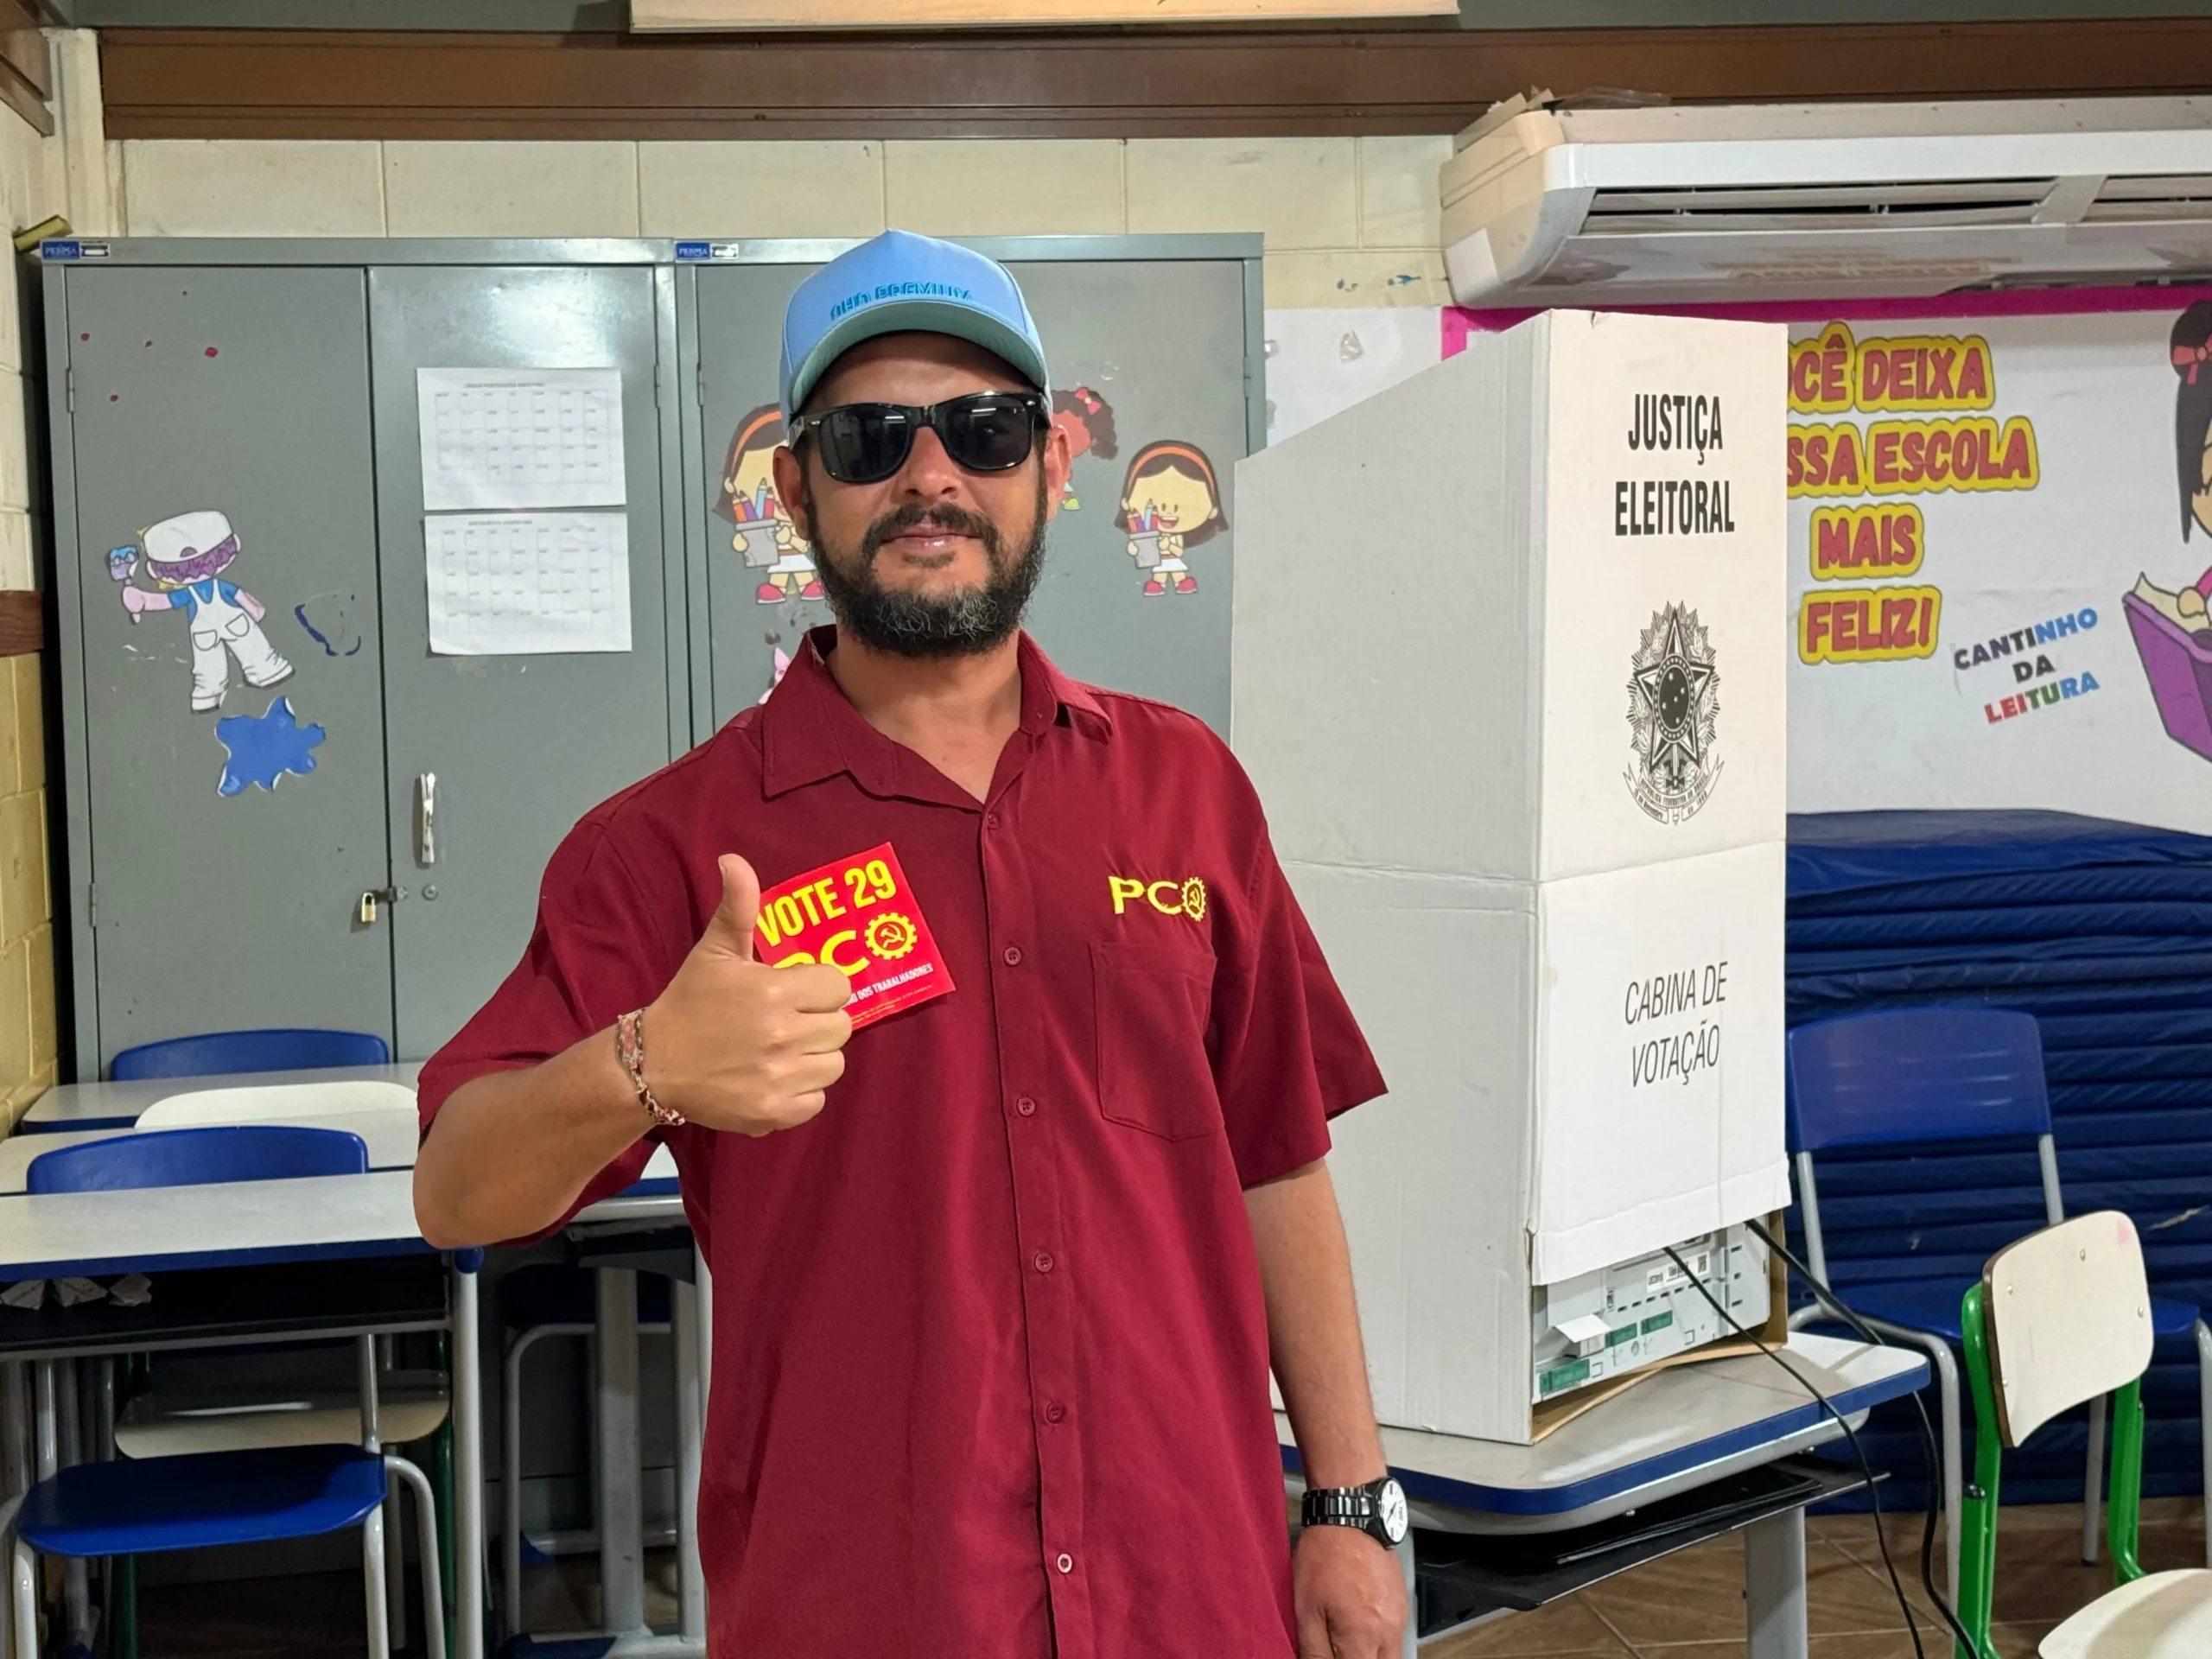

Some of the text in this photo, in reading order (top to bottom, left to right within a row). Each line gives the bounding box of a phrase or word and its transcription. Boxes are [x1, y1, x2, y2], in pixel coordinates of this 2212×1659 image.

[1862, 346, 1987, 402] DEIXA
[1628, 393, 1724, 466] JUSTIÇA
[1874, 428, 2031, 485] ESCOLA
[1615, 480, 1735, 537] ELEITORAL
[1818, 514, 1916, 570] MAIS
[1953, 607, 2099, 671] CANTINHO
[2012, 654, 2056, 683] DA
[1984, 671, 2101, 725] LEITURA
[756, 859, 897, 948] VOTE 29
[856, 987, 874, 1001] DOS
[872, 962, 934, 994] TRABALHADORES
[1624, 960, 1728, 1026] CABINA DE
[1632, 1018, 1720, 1088] VOTAÇÃO
